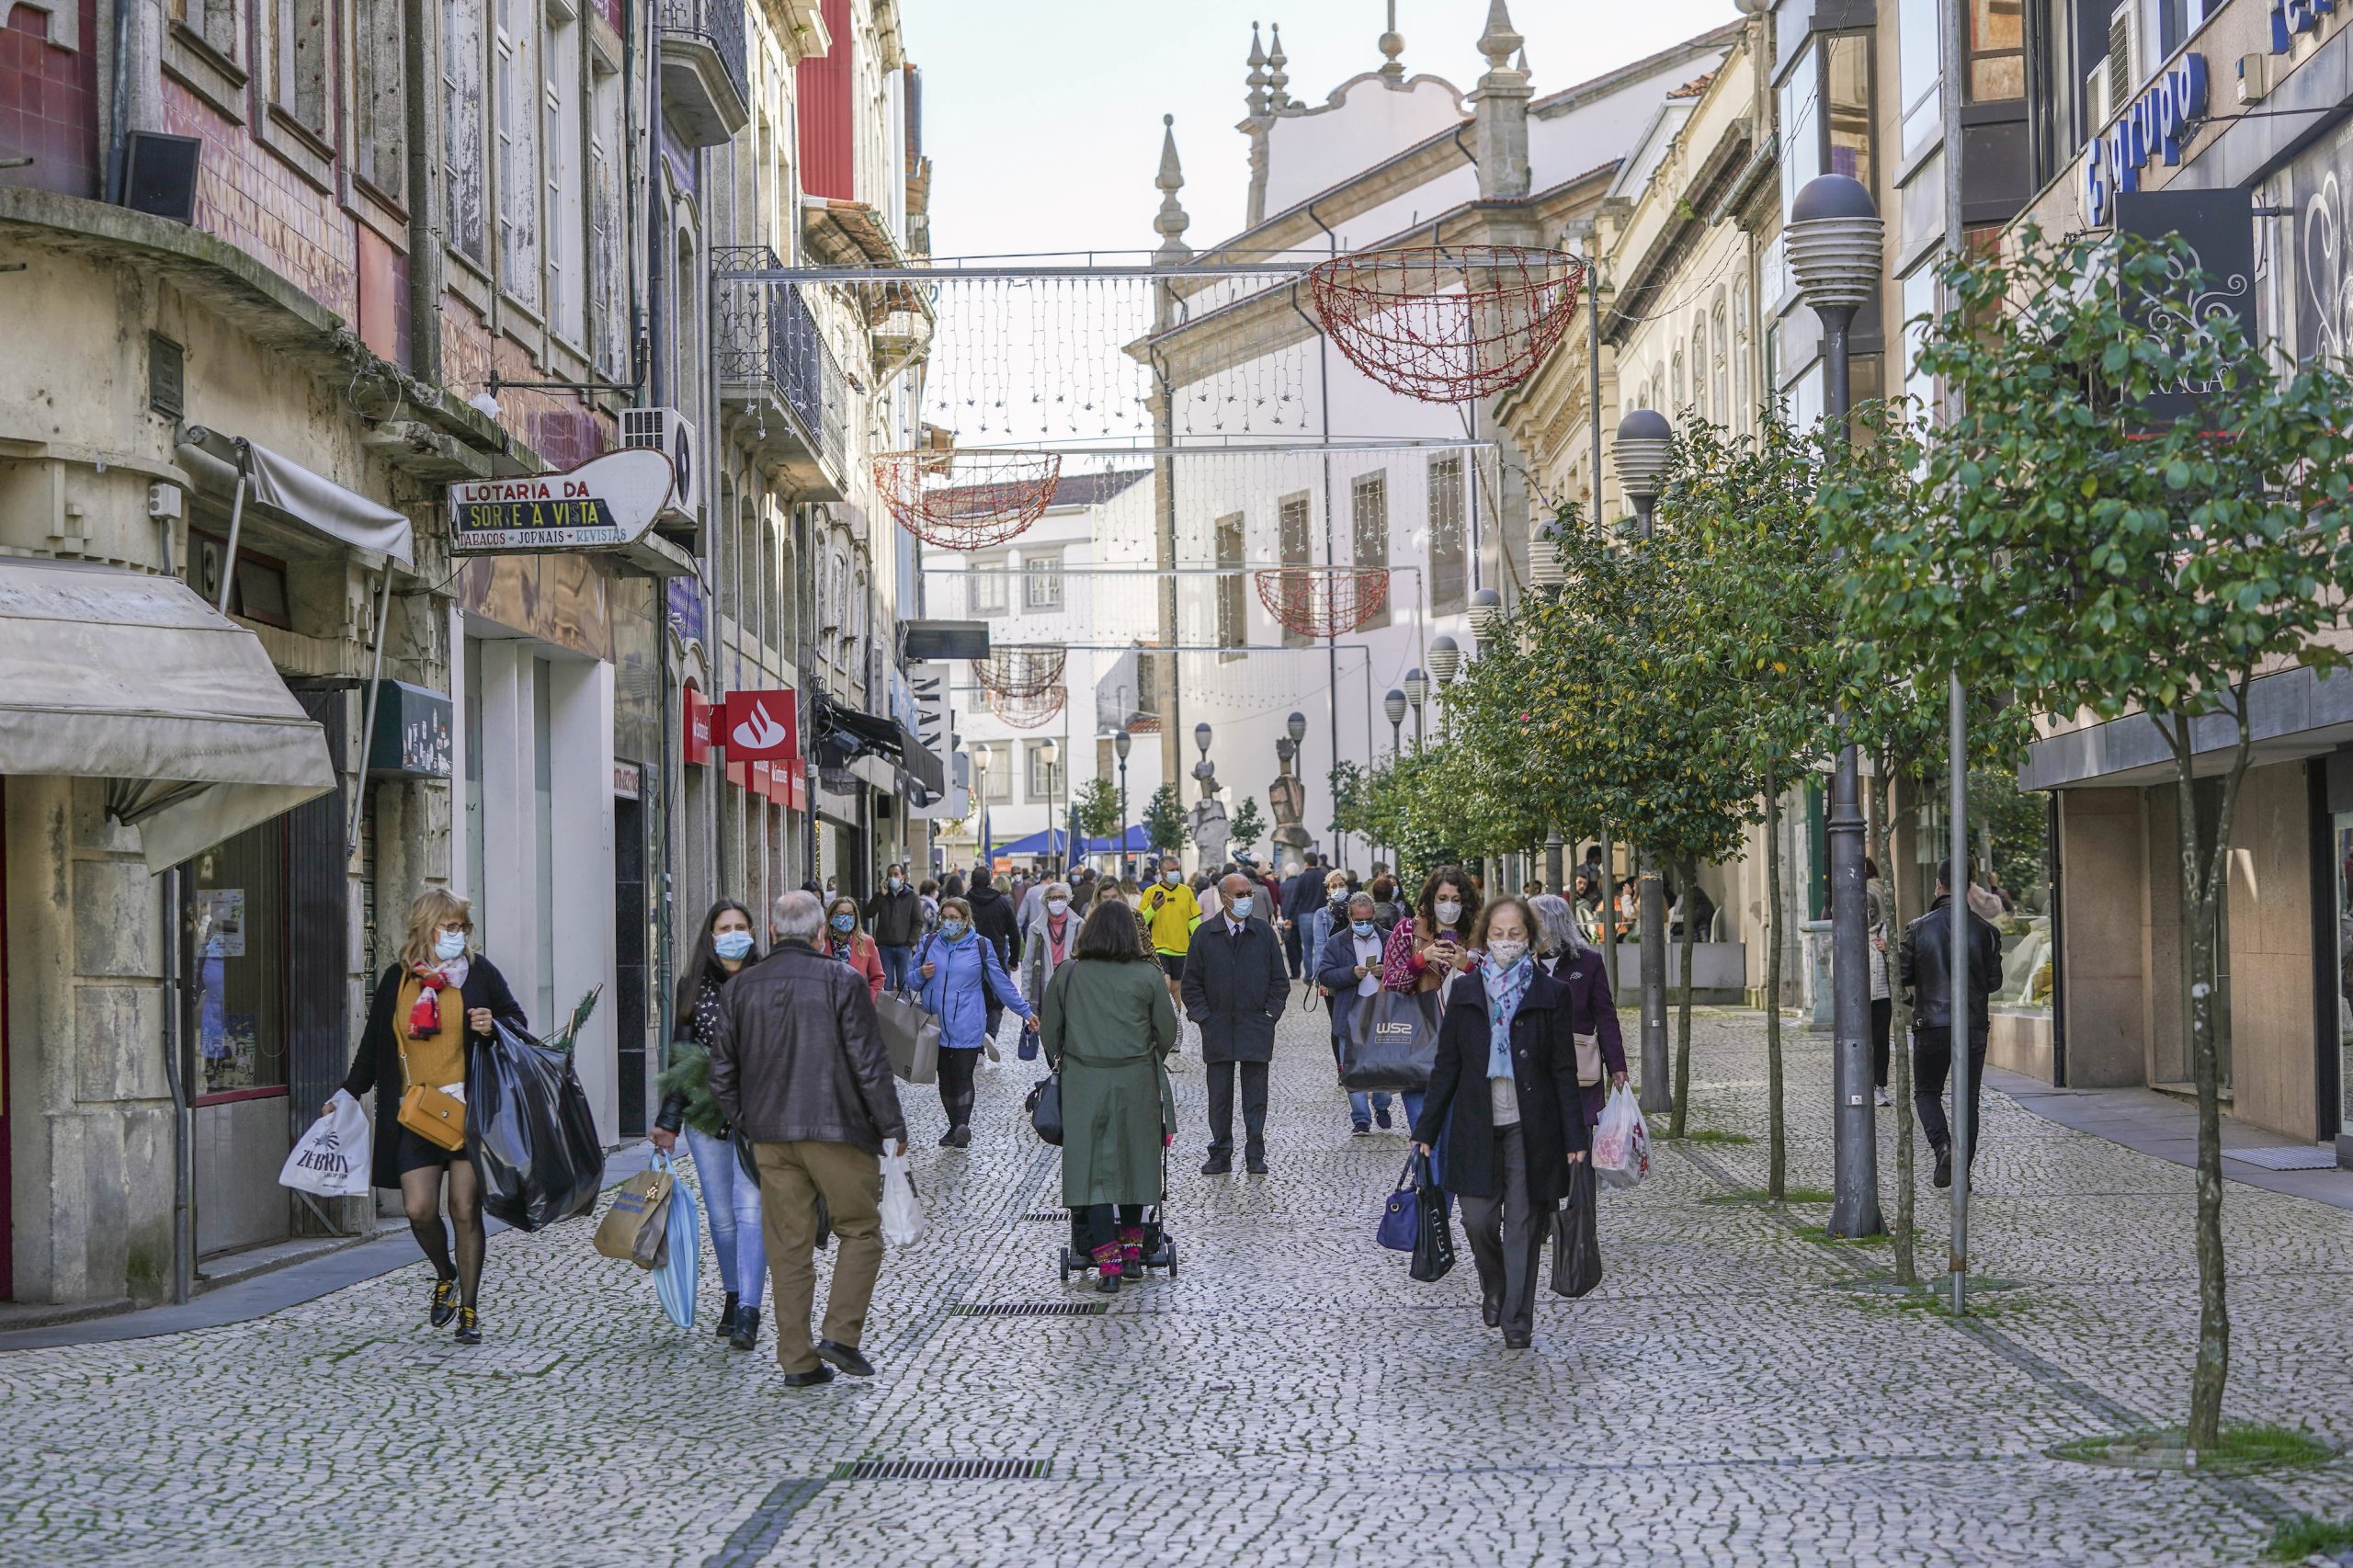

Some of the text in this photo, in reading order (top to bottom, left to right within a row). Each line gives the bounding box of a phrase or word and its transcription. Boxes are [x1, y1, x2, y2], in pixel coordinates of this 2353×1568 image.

[2111, 52, 2205, 193] grupo
[465, 481, 590, 502] LOTARIA DA
[459, 532, 506, 547] TABACOS
[576, 528, 627, 542] REVISTAS
[296, 1149, 348, 1173] ZEBRA
